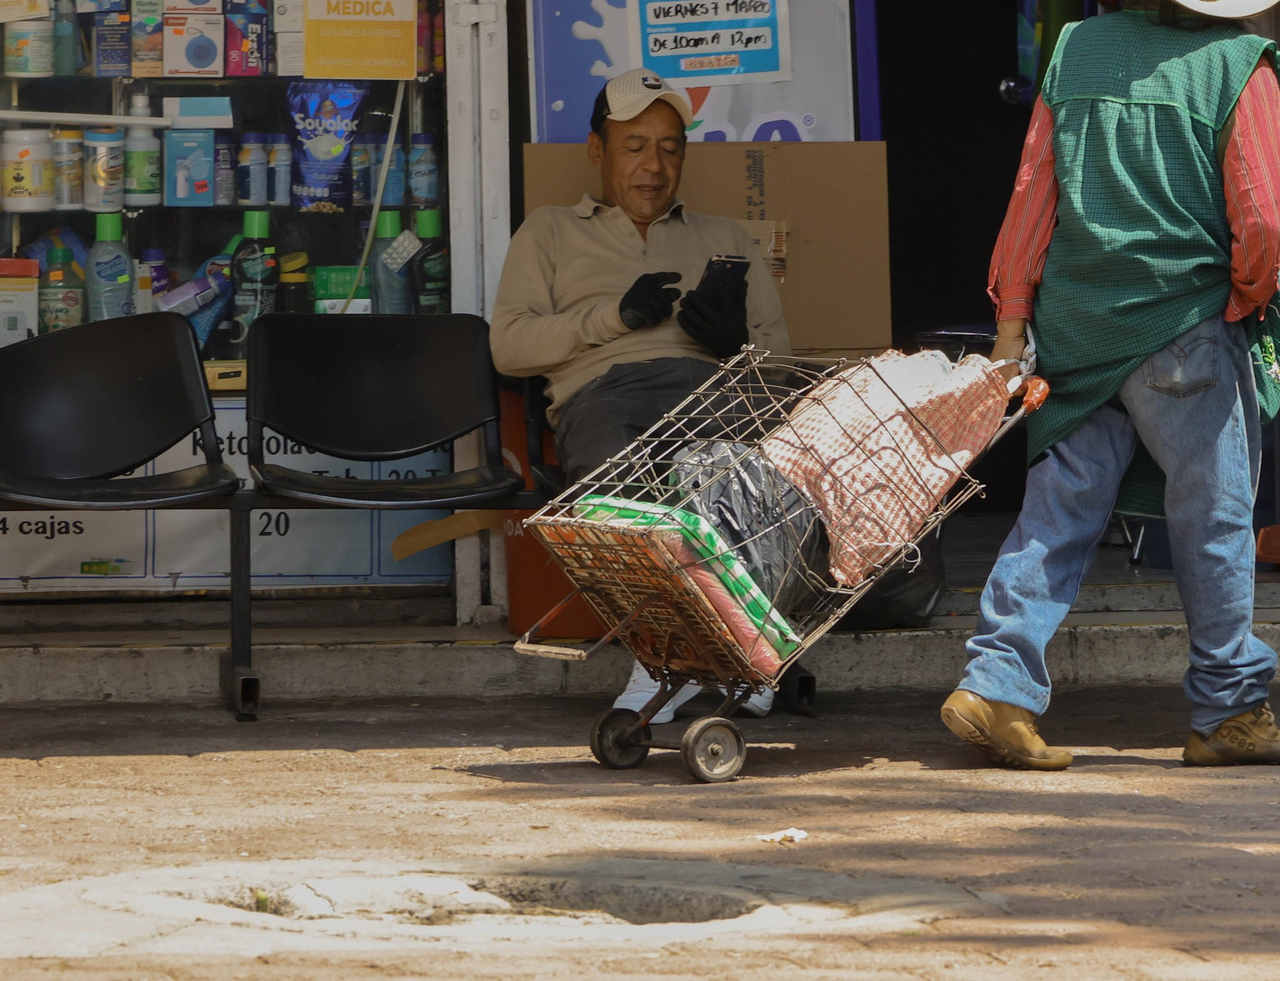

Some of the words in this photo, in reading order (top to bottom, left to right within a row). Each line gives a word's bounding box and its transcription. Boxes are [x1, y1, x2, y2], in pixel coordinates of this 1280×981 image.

[326, 1, 395, 16] MEDICA
[293, 113, 361, 133] Soyalac
[18, 516, 85, 541] cajas
[258, 511, 291, 537] 20
